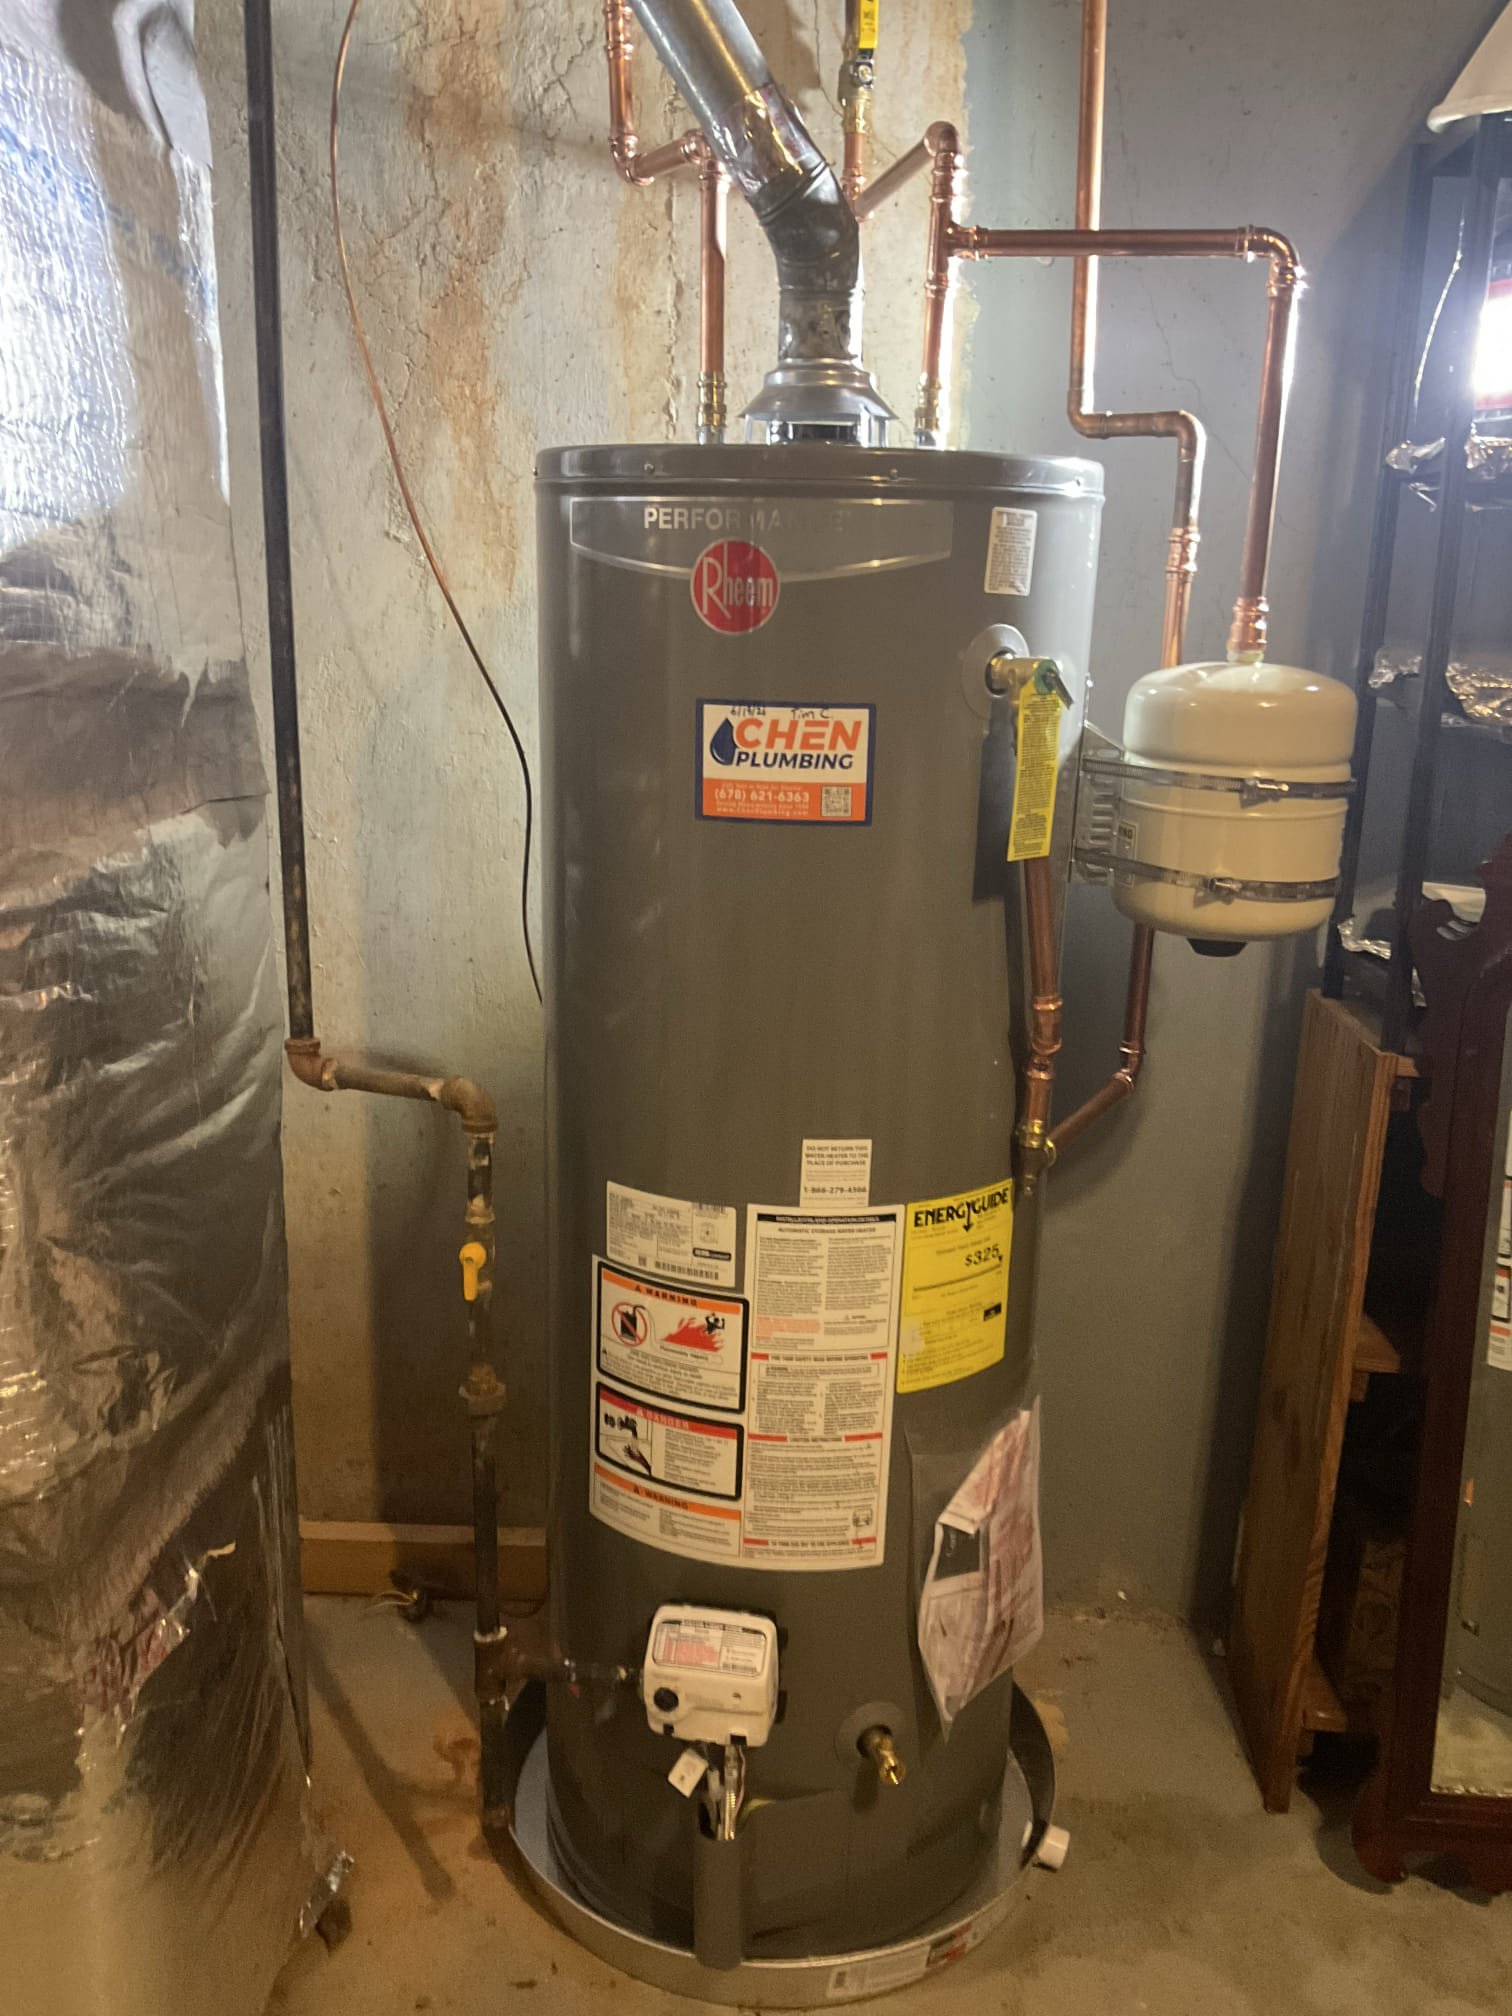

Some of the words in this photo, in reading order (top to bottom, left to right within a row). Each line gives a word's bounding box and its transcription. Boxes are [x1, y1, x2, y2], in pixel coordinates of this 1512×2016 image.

[701, 542, 774, 620] Rheem
[735, 717, 862, 751] CHEN
[735, 751, 854, 770] PLUMBING
[714, 788, 746, 801] (678)
[750, 790, 810, 803] 621-6363
[964, 1242, 1000, 1267] $325
[644, 1286, 699, 1307] WARNING
